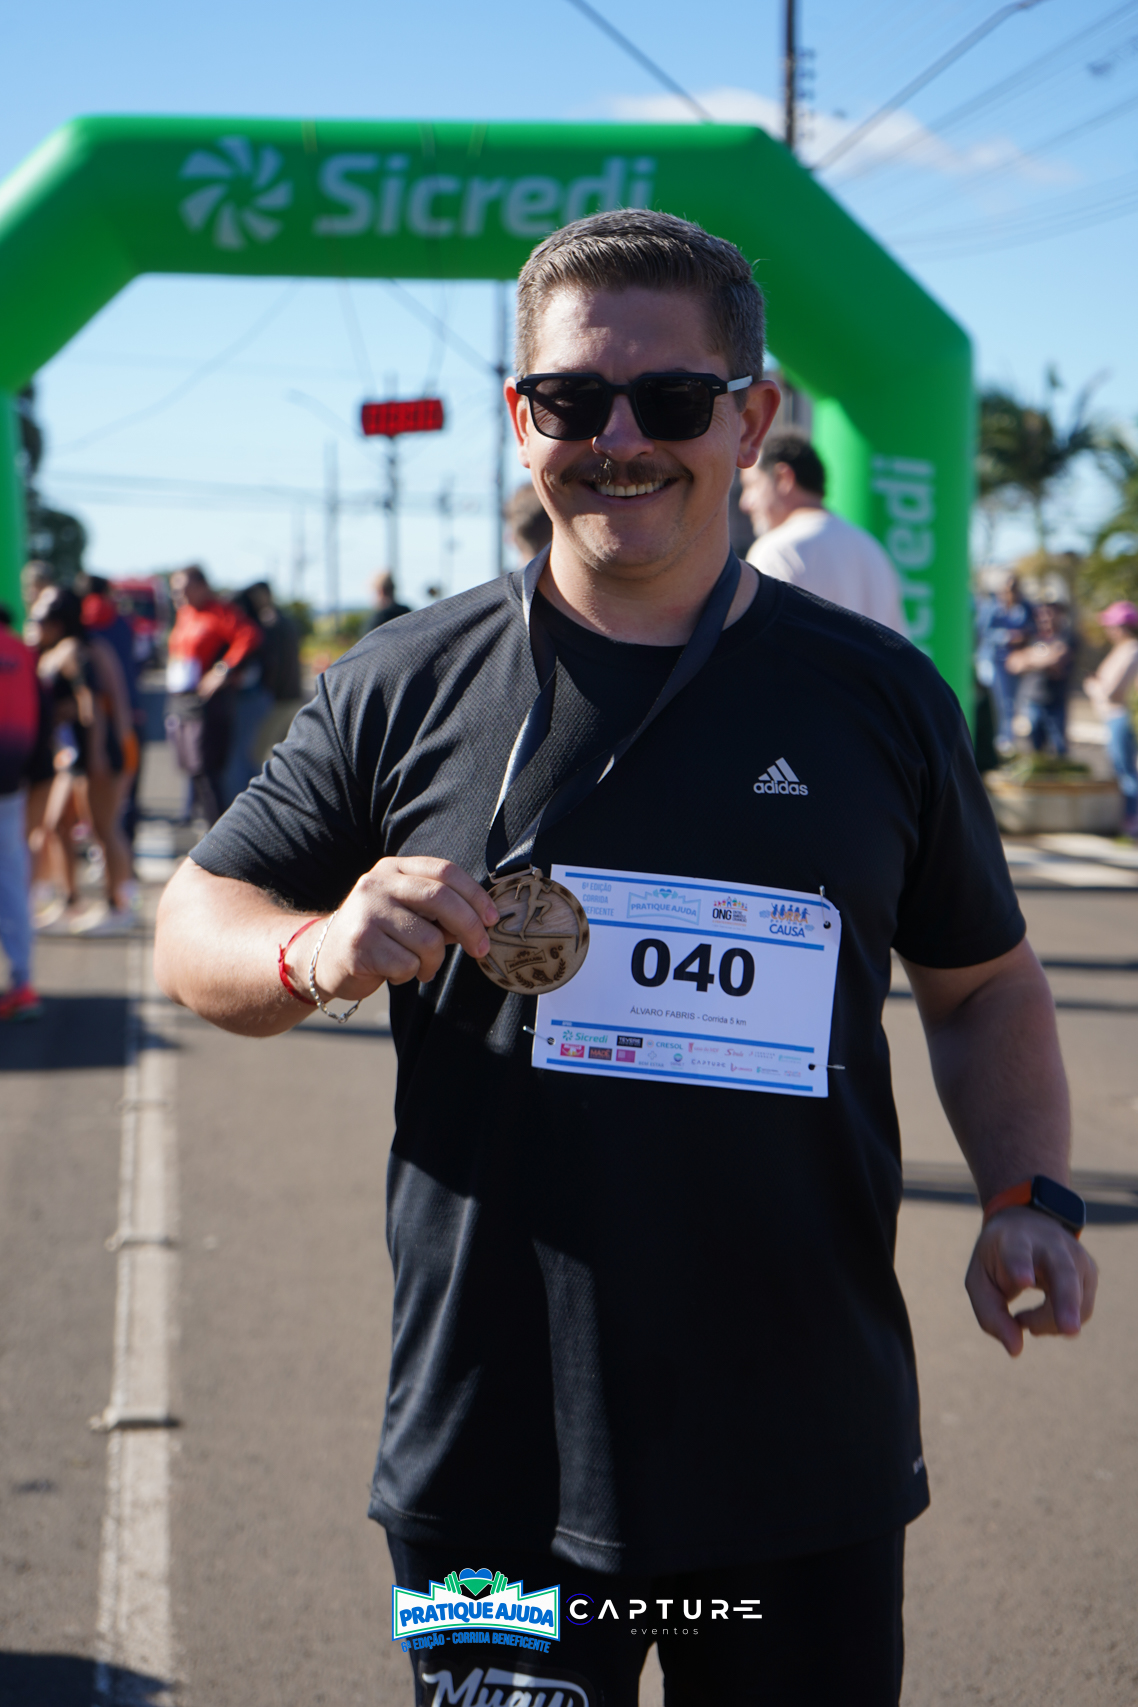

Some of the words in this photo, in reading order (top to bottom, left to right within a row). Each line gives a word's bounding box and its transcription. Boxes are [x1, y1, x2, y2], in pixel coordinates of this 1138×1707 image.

[753, 780, 809, 796] adidas
[582, 893, 609, 904] CORRIDA
[630, 902, 671, 912] PRATIQUE
[671, 904, 697, 917] AJUDA
[712, 907, 733, 921] ONG
[769, 923, 806, 938] CAUSA
[630, 938, 756, 997] 040
[630, 1005, 664, 1017] ÁLVARO
[665, 1010, 696, 1021] FABRIS
[702, 1014, 728, 1024] Corrida
[729, 1017, 735, 1025] 5
[735, 1018, 747, 1026] km
[574, 1032, 609, 1044] Sicredi
[655, 1041, 684, 1050] CRESOL
